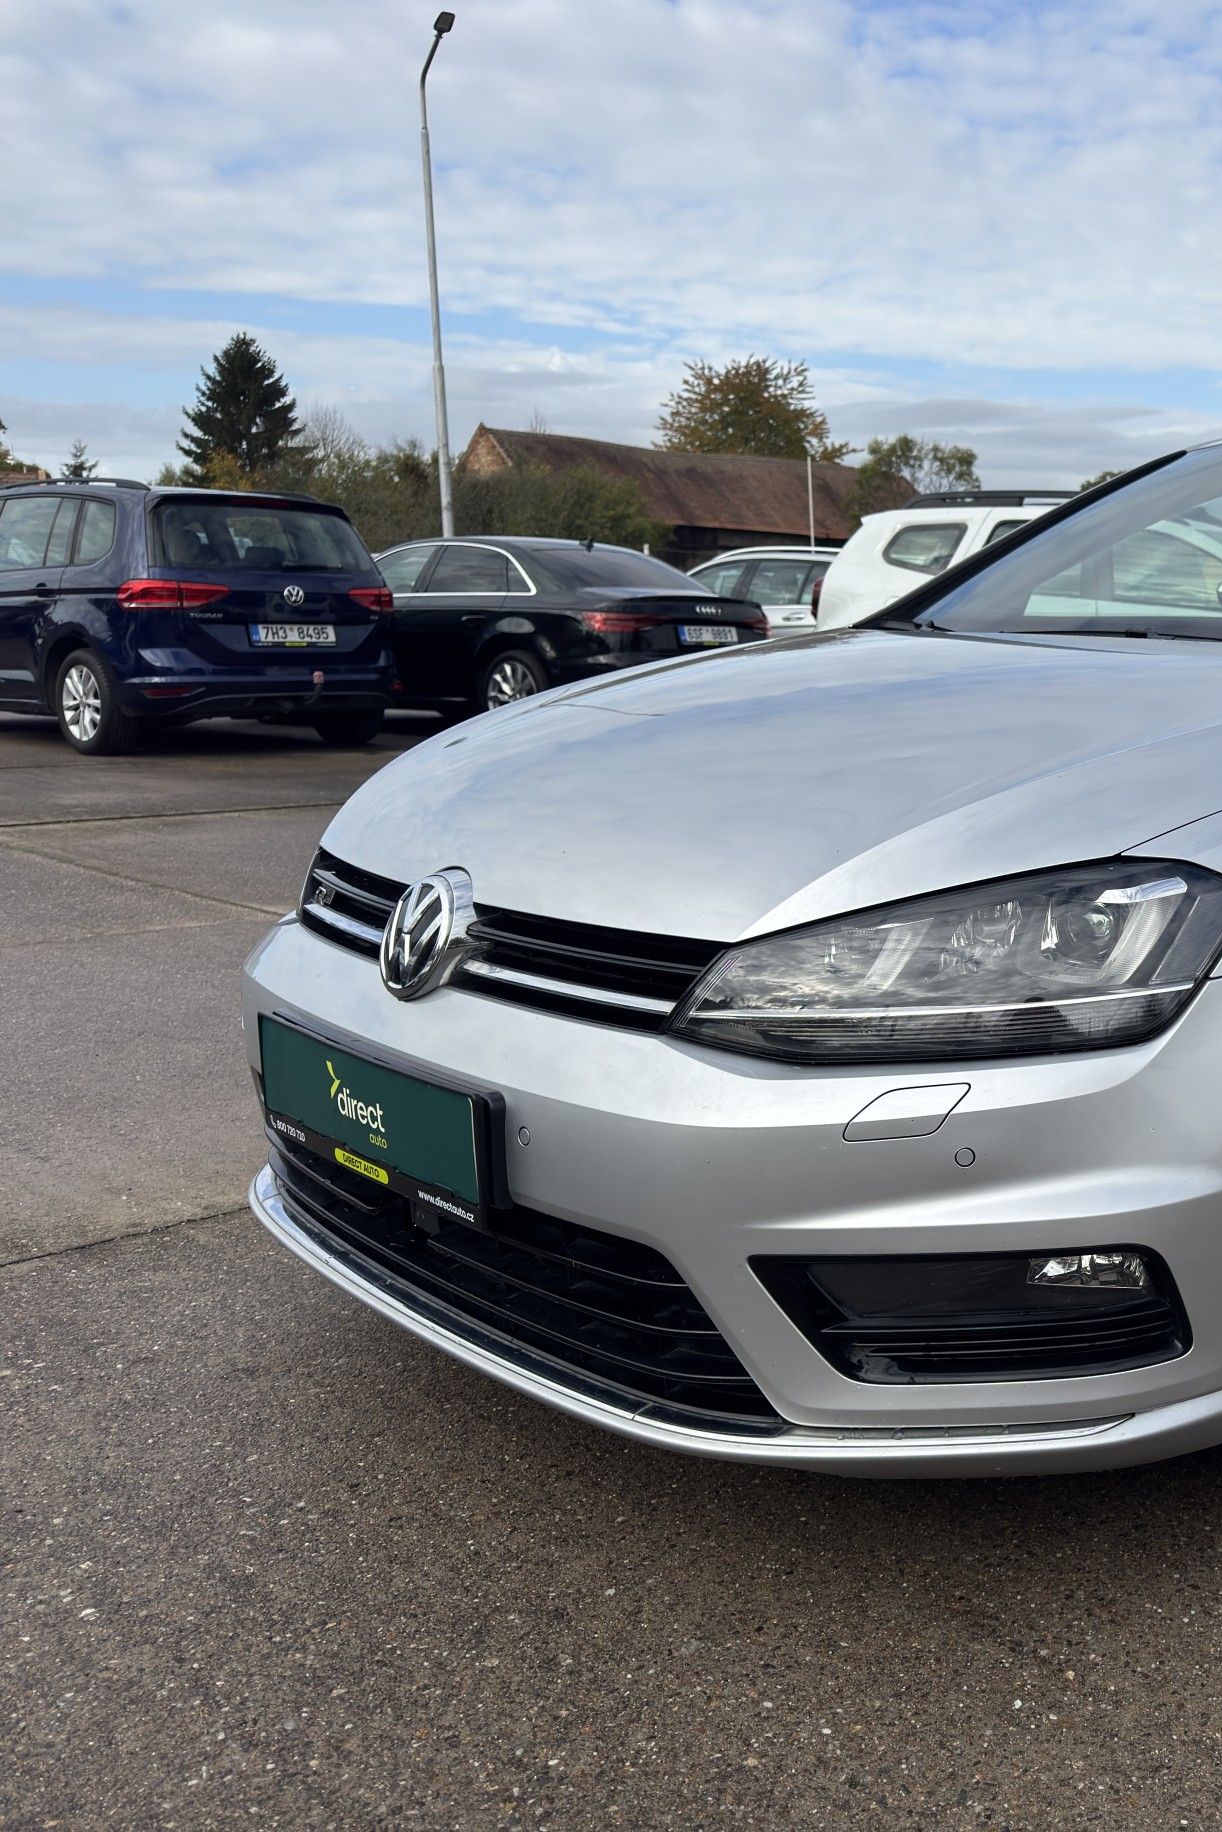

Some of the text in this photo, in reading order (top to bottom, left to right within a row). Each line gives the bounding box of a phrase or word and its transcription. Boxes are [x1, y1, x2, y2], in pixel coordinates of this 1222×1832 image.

[261, 625, 329, 641] 7H3 8495
[337, 1087, 385, 1133] direct
[276, 1119, 287, 1133] 800
[286, 1124, 296, 1137] 720
[369, 1132, 388, 1149] auto
[342, 1153, 380, 1179] DIRECT AUTO
[417, 1189, 475, 1223] www.directauto.cz
